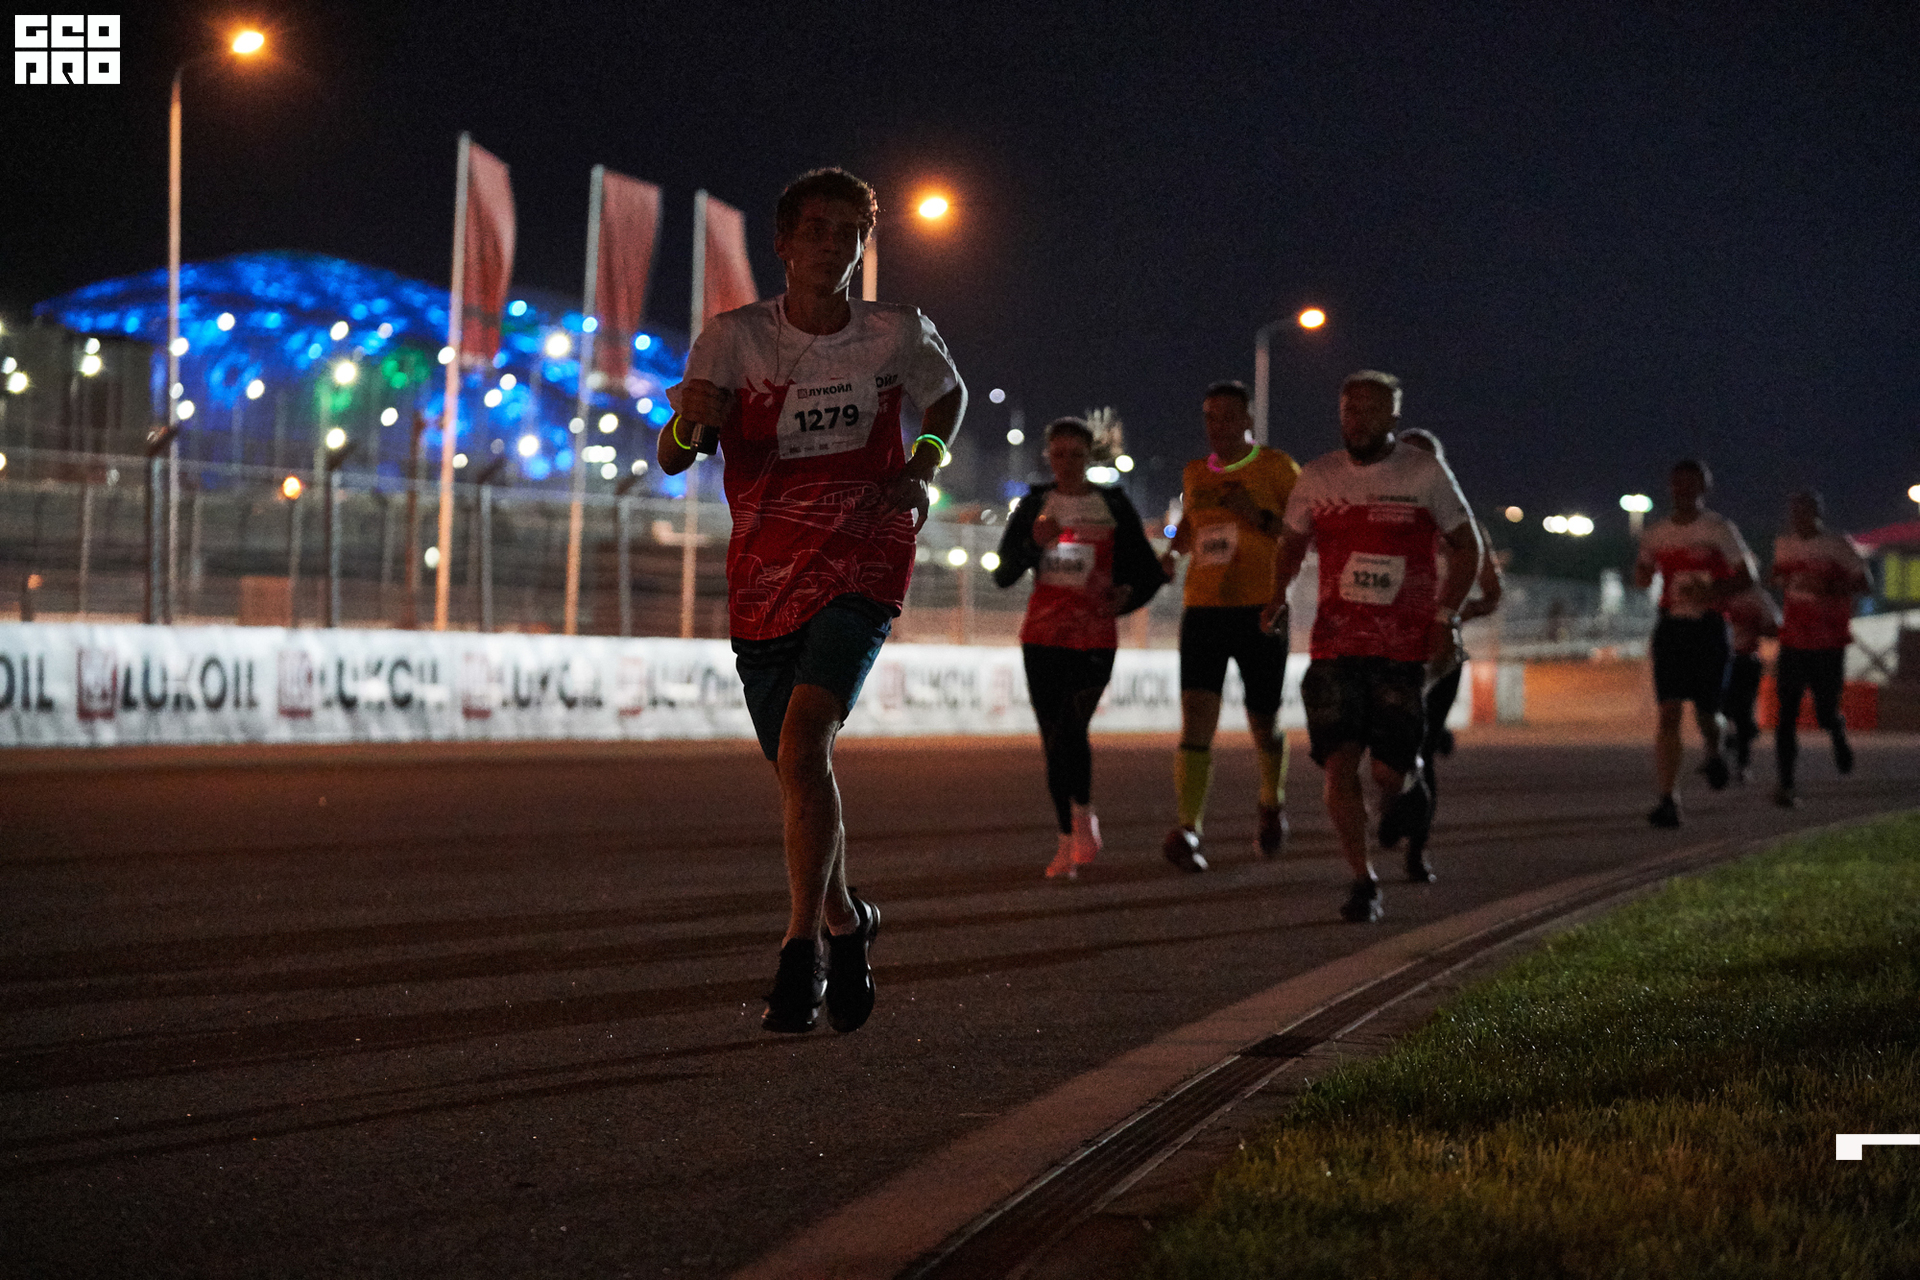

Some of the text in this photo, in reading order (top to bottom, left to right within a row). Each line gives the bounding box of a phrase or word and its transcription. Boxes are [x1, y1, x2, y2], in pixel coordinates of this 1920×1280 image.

[808, 383, 852, 397] ЛУКОЙЛ
[794, 404, 859, 432] 1279
[1353, 571, 1391, 589] 1216
[122, 655, 259, 710] LUKOIL
